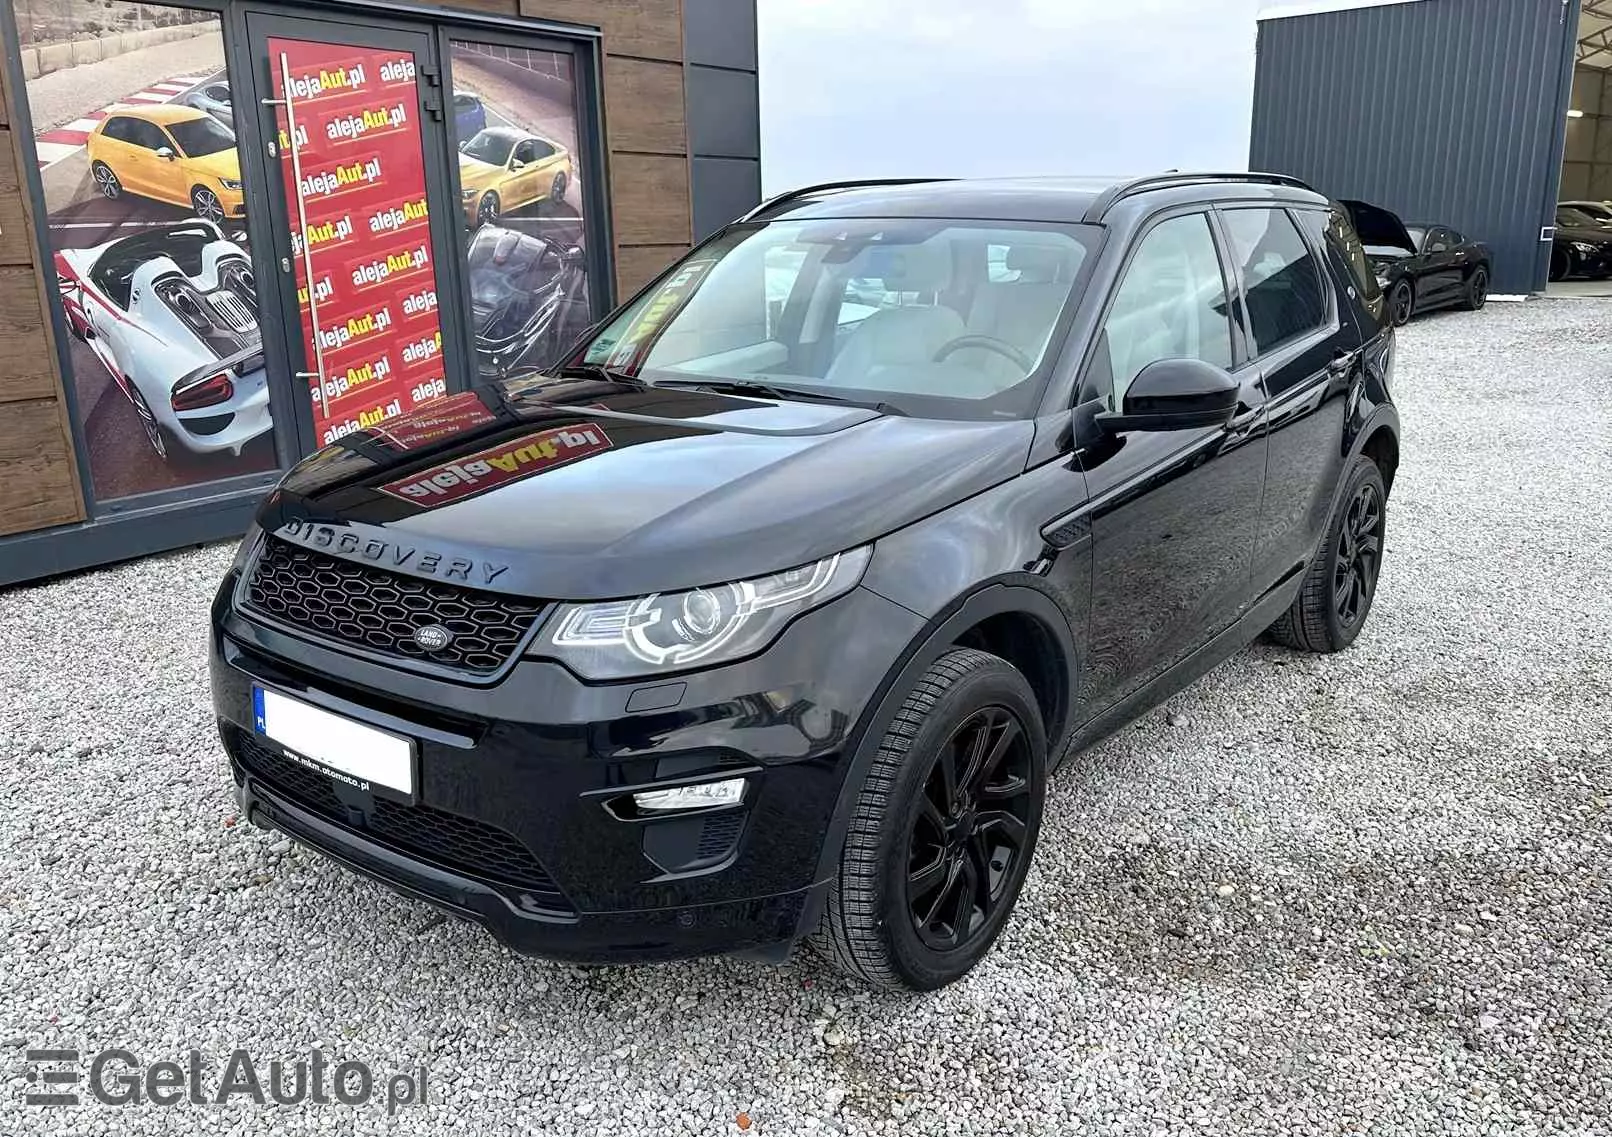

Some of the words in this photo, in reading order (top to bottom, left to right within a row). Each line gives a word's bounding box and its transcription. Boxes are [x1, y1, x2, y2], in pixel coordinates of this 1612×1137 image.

[281, 63, 366, 99] lejaAut.pl
[380, 58, 416, 82] aleja
[326, 103, 407, 140] alejaAut.pl
[301, 157, 382, 197] alejaAut.pl
[369, 198, 429, 232] alejaAut
[351, 245, 429, 286] alejaAut.pl
[402, 290, 438, 314] aleja
[311, 307, 392, 351] lejaAut.pl
[311, 356, 391, 402] aejaAut.pl
[411, 378, 446, 402] aleja
[323, 398, 402, 445] alejaAut.pl
[284, 516, 509, 585] DISCOVERY
[282, 749, 370, 792] www.mkm.otomoto.pl
